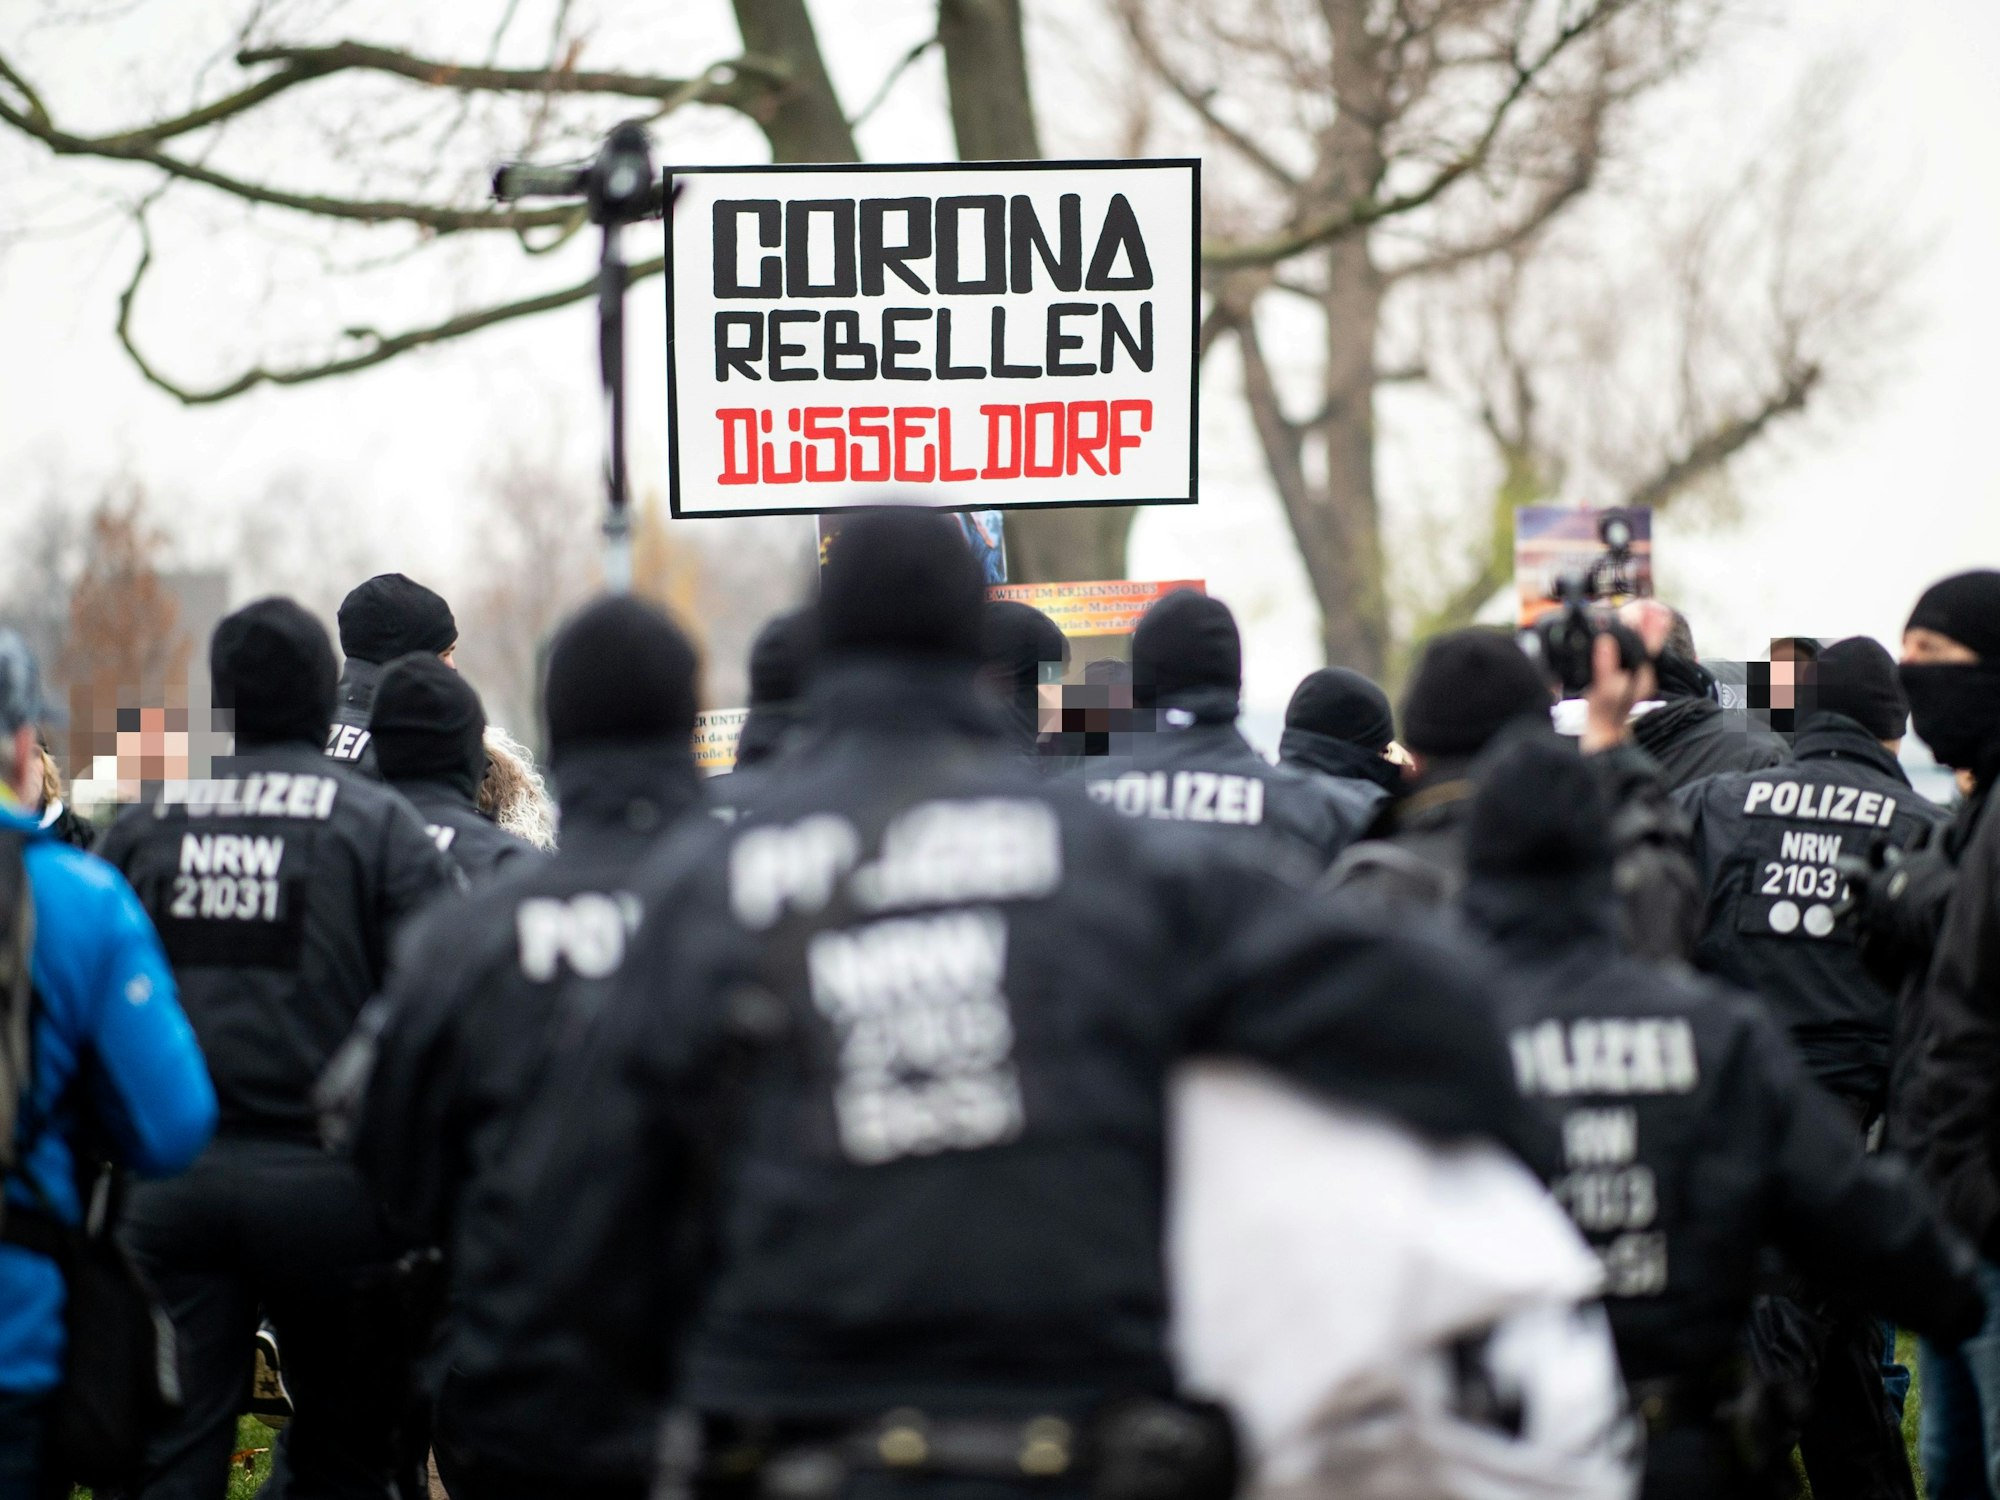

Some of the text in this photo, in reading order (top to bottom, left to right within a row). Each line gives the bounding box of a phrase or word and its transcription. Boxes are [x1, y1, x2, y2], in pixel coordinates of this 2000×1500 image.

[712, 193, 1154, 299] CORONA
[715, 301, 1153, 382] REBELLEN
[715, 399, 1153, 486] DÜSSELDORF
[1035, 587, 1053, 598] IM
[1057, 583, 1157, 598] KRISENMODUS
[1743, 781, 1897, 828] POLIZEI
[179, 832, 285, 878] NRW
[1780, 830, 1842, 865] NRW
[169, 876, 280, 922] 21031
